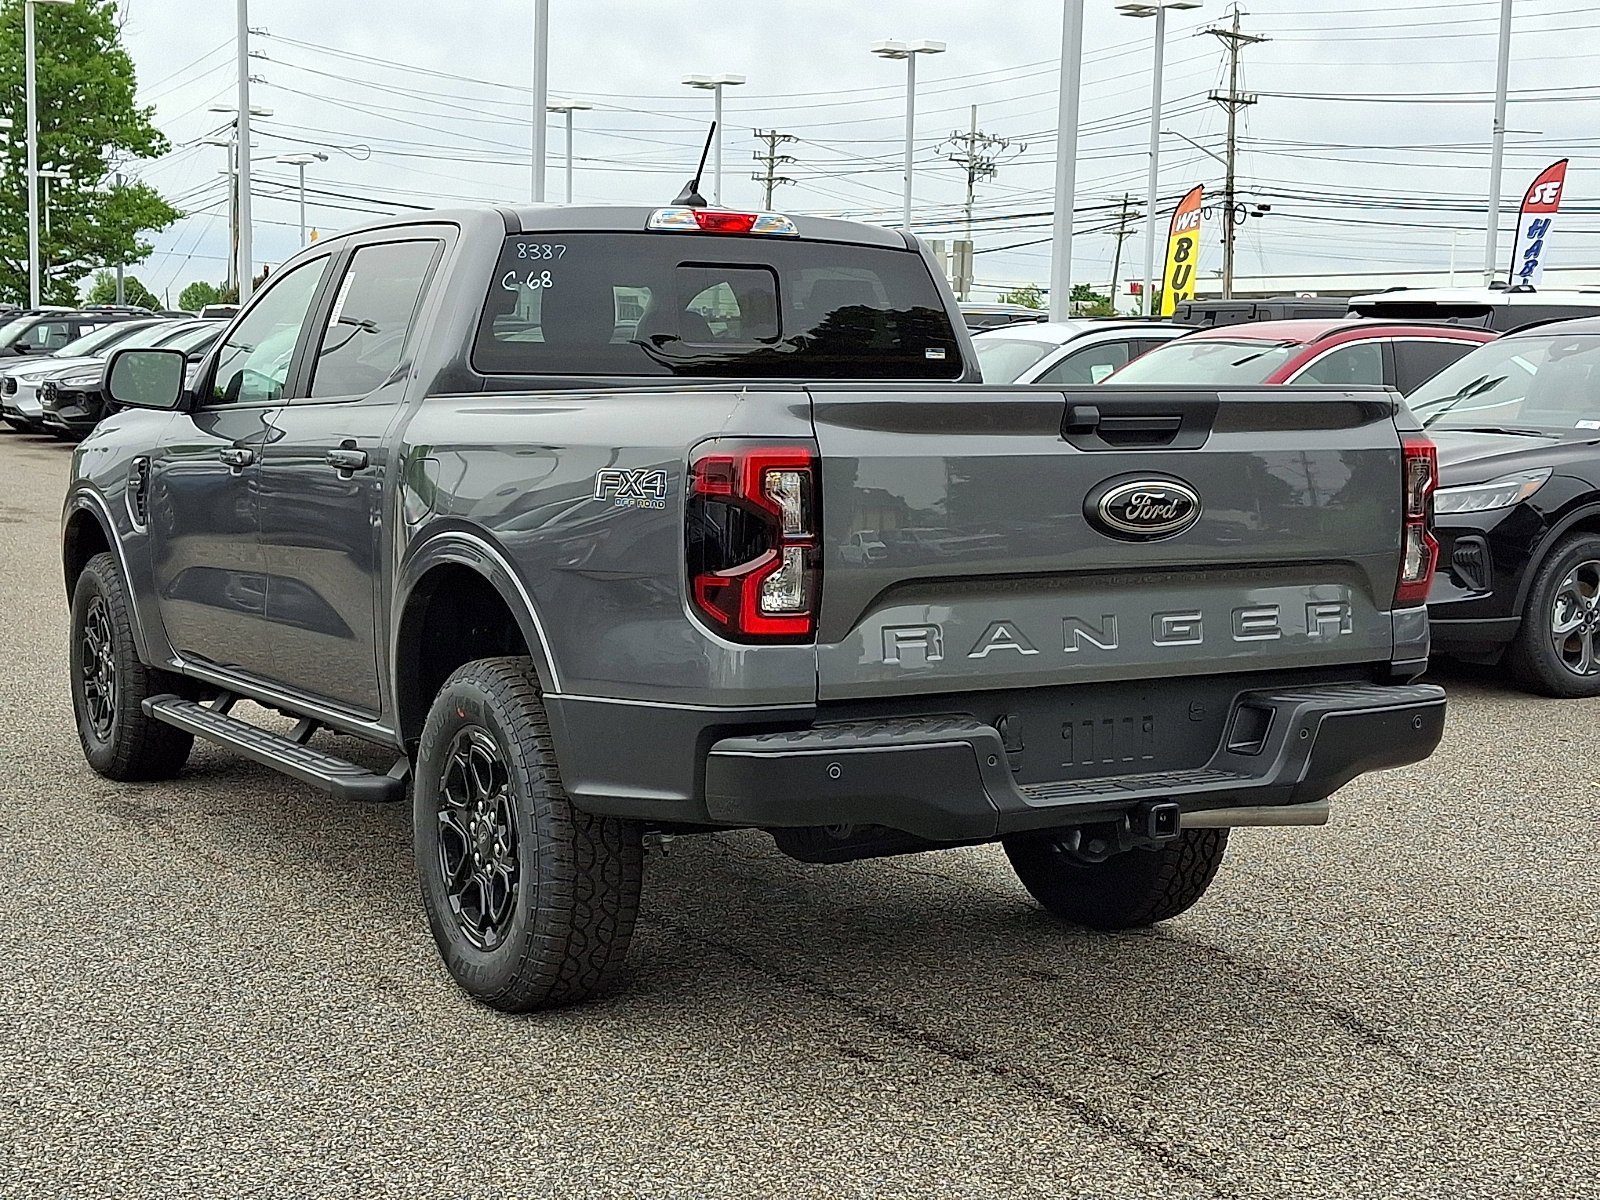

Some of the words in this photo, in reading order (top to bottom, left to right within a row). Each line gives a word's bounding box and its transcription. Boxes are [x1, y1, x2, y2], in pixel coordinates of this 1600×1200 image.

[1528, 181, 1561, 205] SE
[1174, 208, 1202, 232] WE
[516, 243, 567, 260] 8387
[593, 467, 668, 501] FX4
[615, 497, 635, 508] OFF
[637, 498, 666, 510] ROAD
[1125, 492, 1178, 520] Ford
[880, 600, 1354, 665] RANGER
